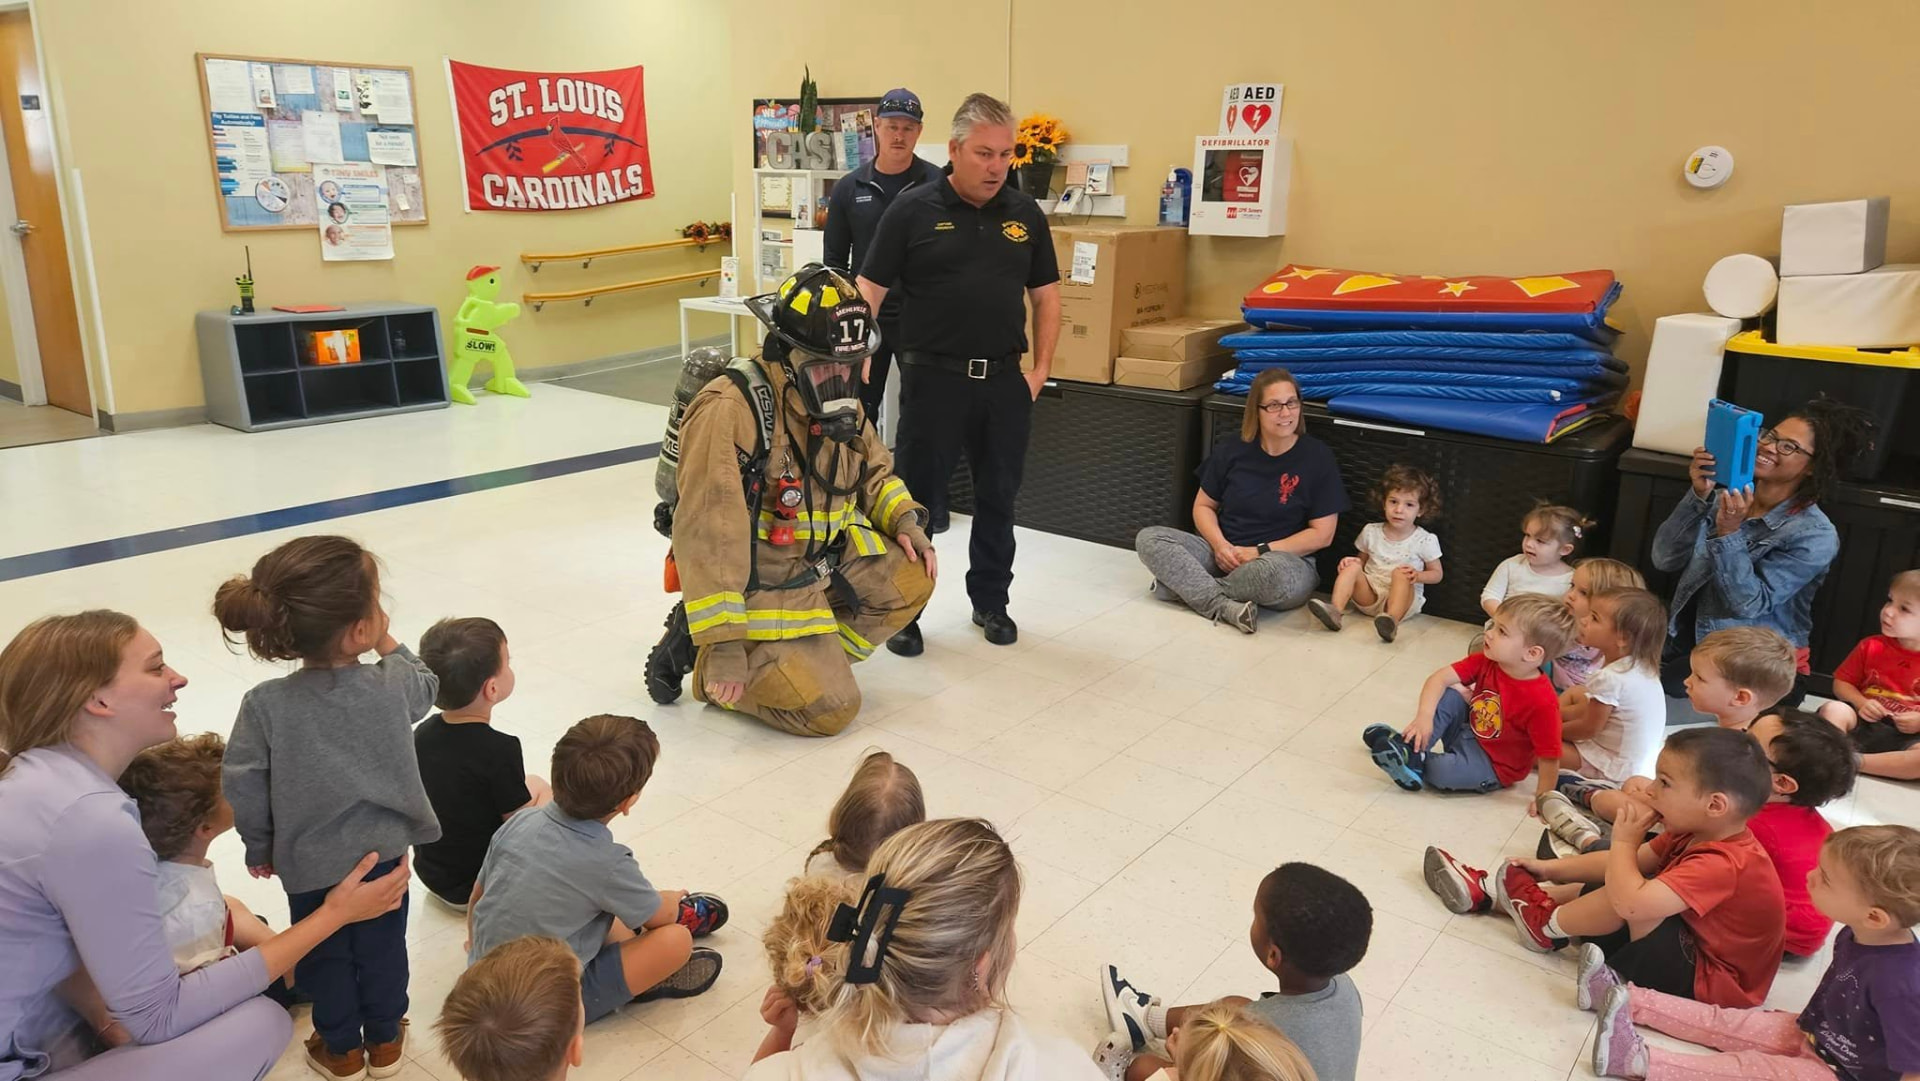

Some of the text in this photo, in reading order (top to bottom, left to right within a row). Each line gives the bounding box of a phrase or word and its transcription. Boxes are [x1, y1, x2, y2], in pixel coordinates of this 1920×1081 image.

[488, 77, 625, 127] ST. LOUIS
[1229, 87, 1240, 100] AED
[1243, 87, 1275, 100] AED
[766, 131, 833, 170] CAS
[1201, 139, 1270, 147] DEFIBRILLATOR
[482, 164, 643, 210] CARDINALS
[840, 319, 865, 343] 17
[466, 341, 495, 351] SLOW!
[757, 386, 773, 432] MSA
